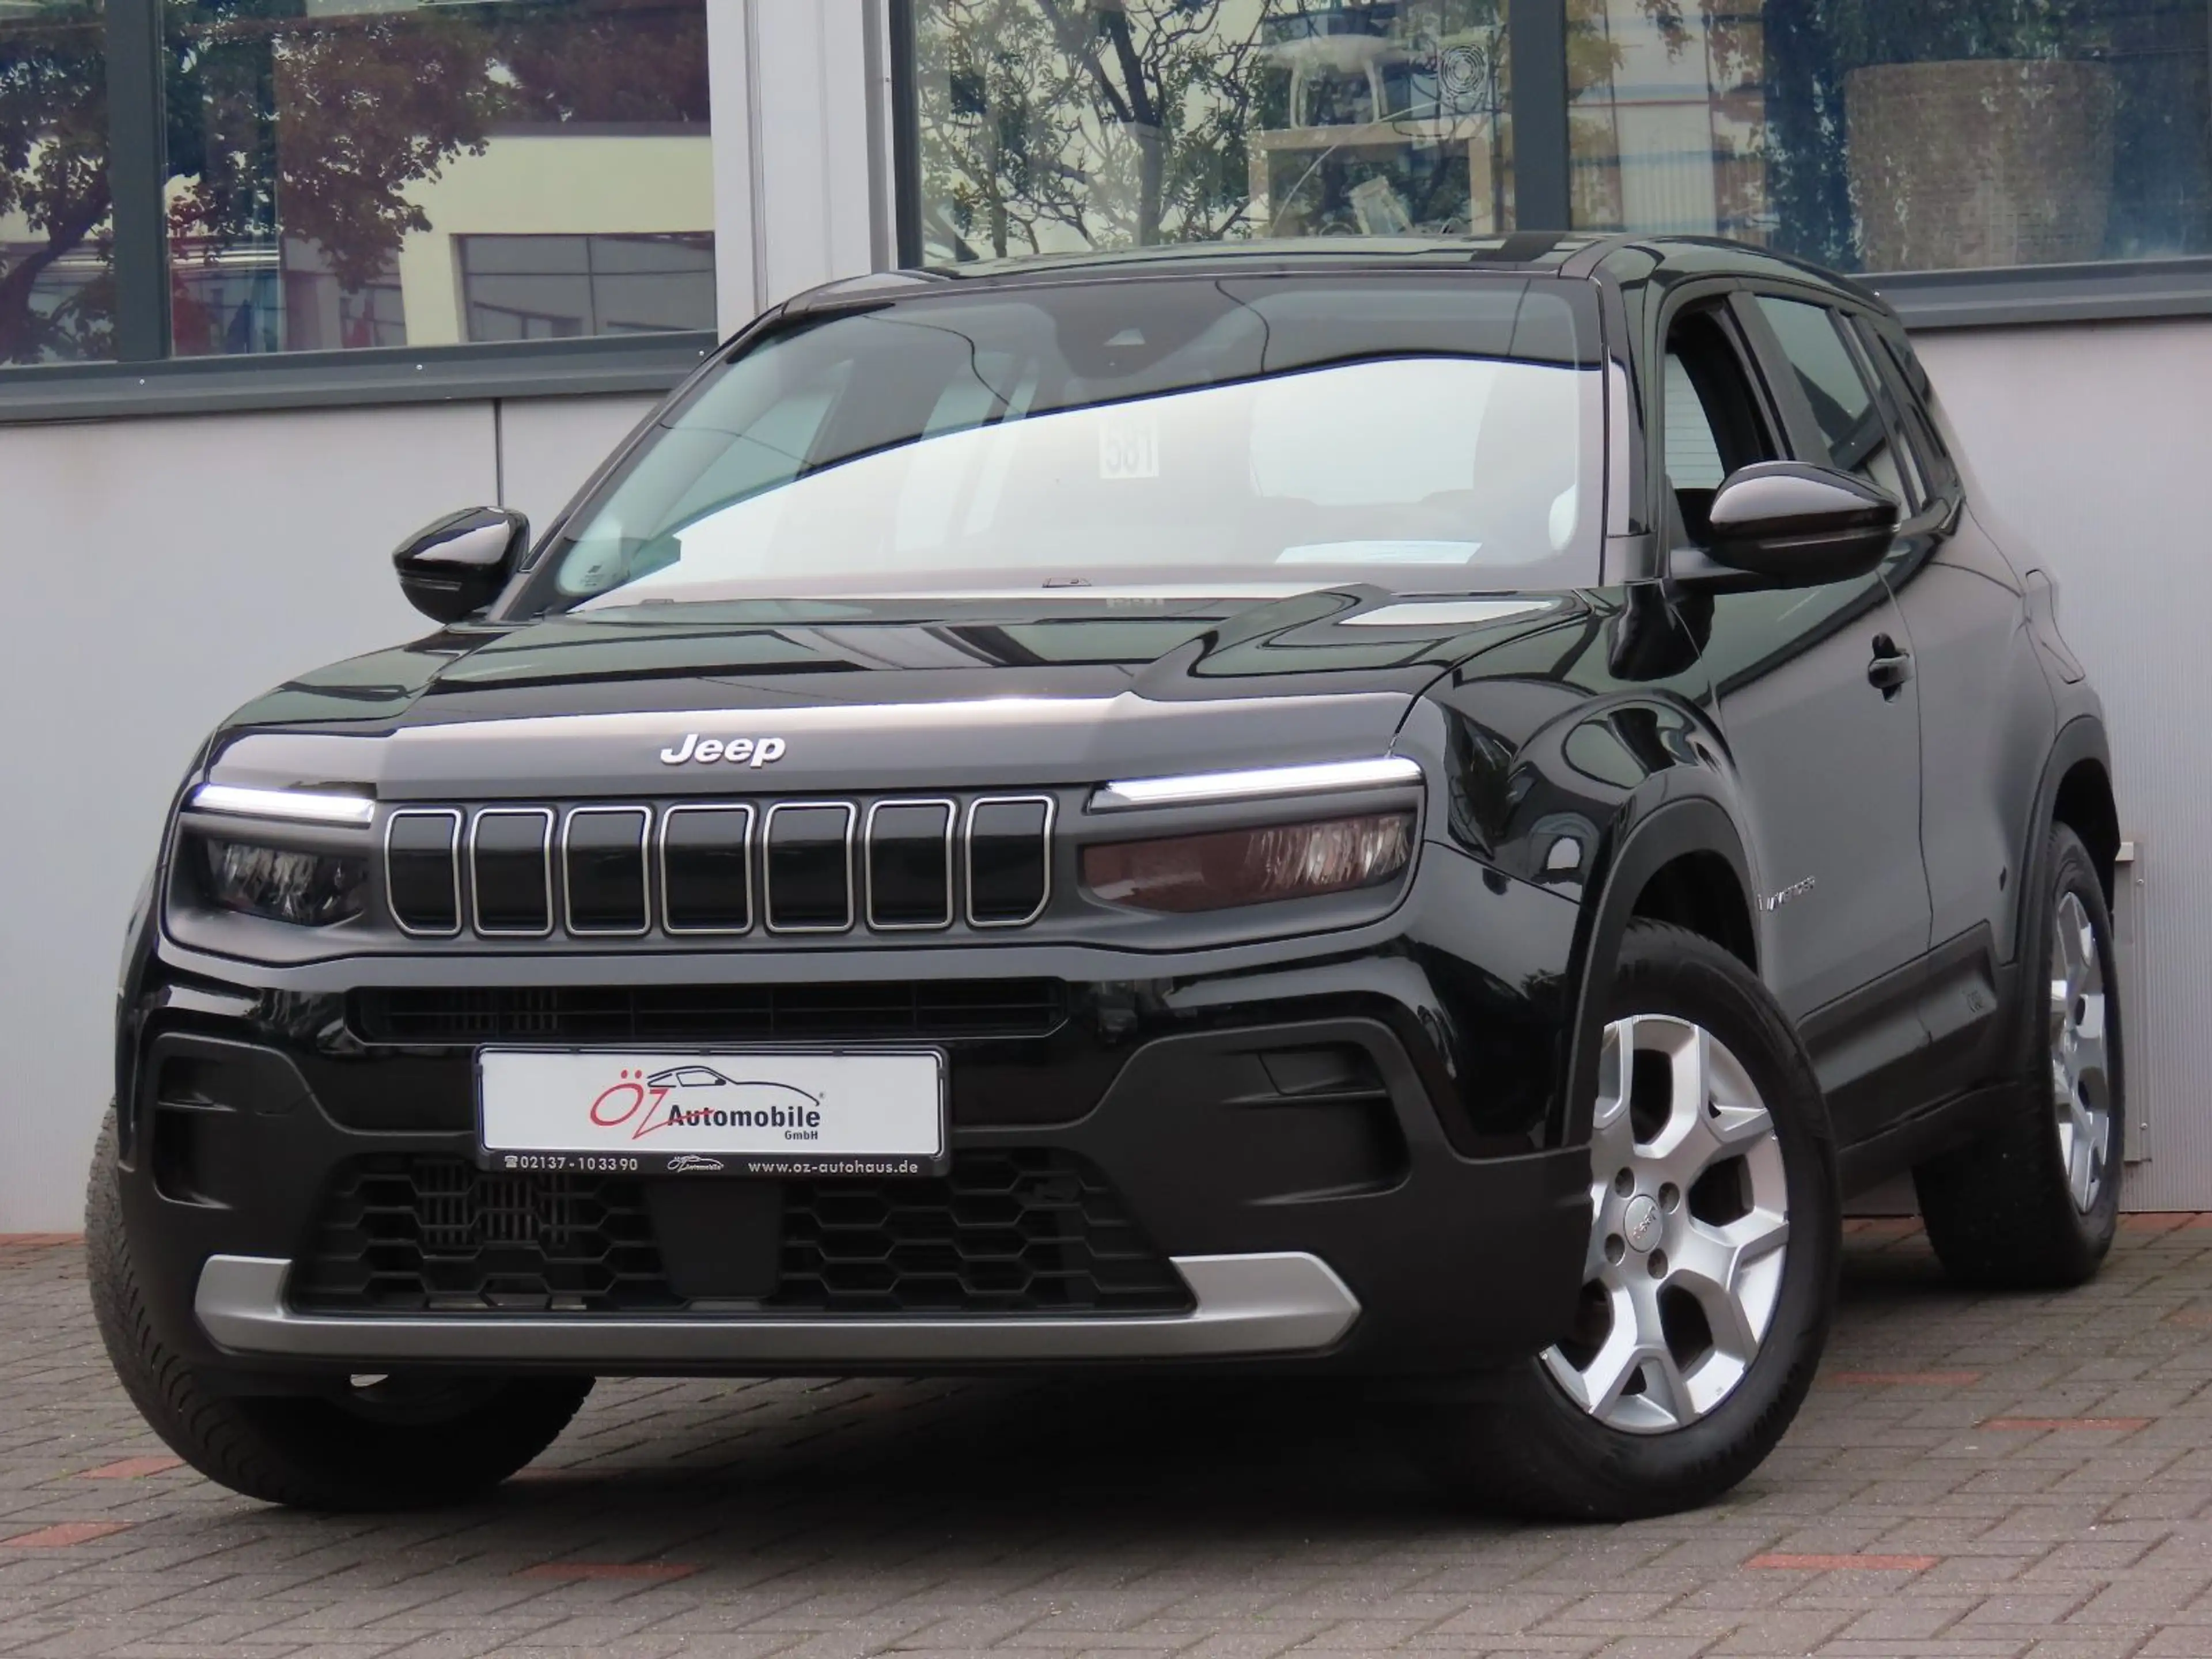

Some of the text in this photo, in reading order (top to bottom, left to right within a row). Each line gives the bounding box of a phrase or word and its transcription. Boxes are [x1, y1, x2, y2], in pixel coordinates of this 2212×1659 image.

[660, 733, 786, 768] Jeep
[667, 1104, 821, 1127] Automobile
[784, 1130, 819, 1141] GmbH
[748, 1160, 918, 1173] www.oz-autohaus.de
